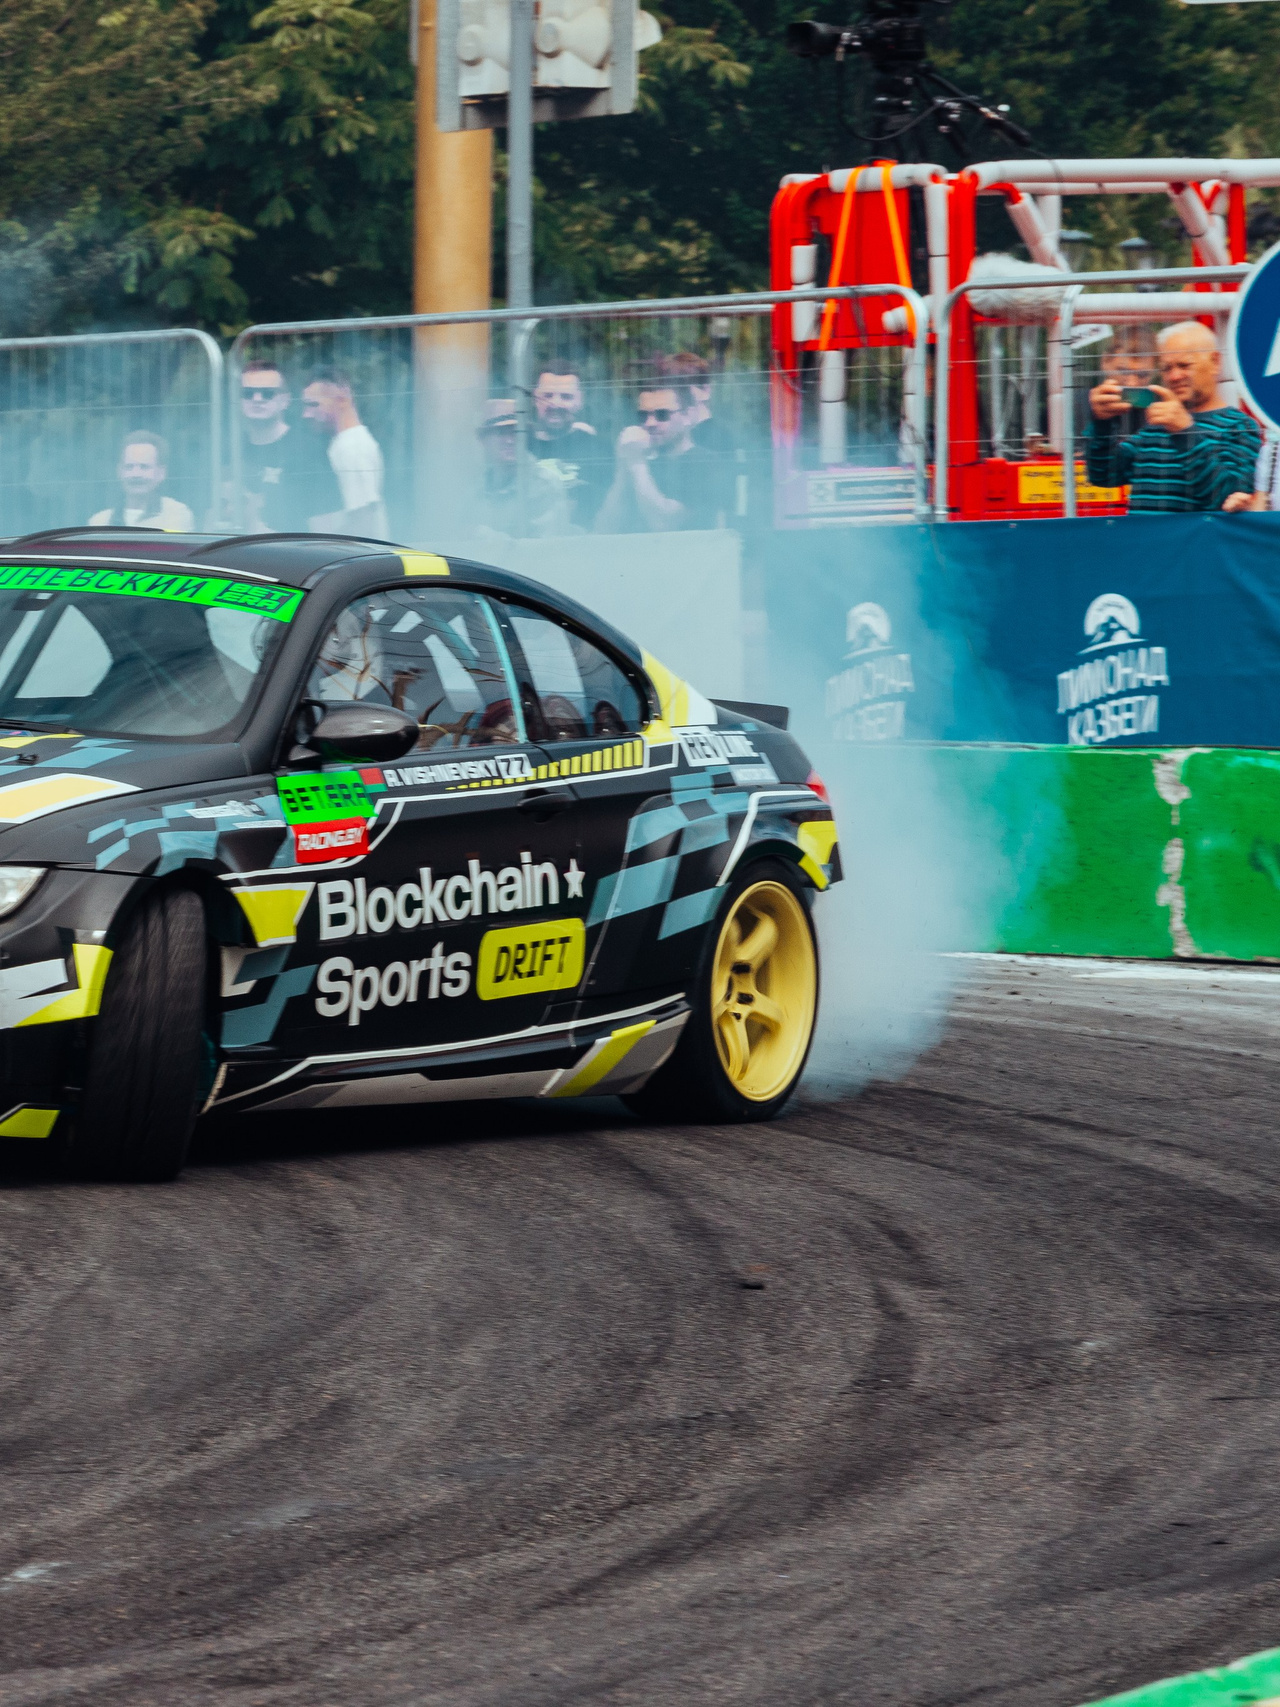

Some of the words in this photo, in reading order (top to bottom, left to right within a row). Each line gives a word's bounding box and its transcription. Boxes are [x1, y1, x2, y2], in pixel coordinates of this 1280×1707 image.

[282, 782, 372, 813] BETERA
[318, 851, 559, 940] Blockchain
[315, 941, 472, 1026] Sports
[493, 936, 573, 984] DRIFT
